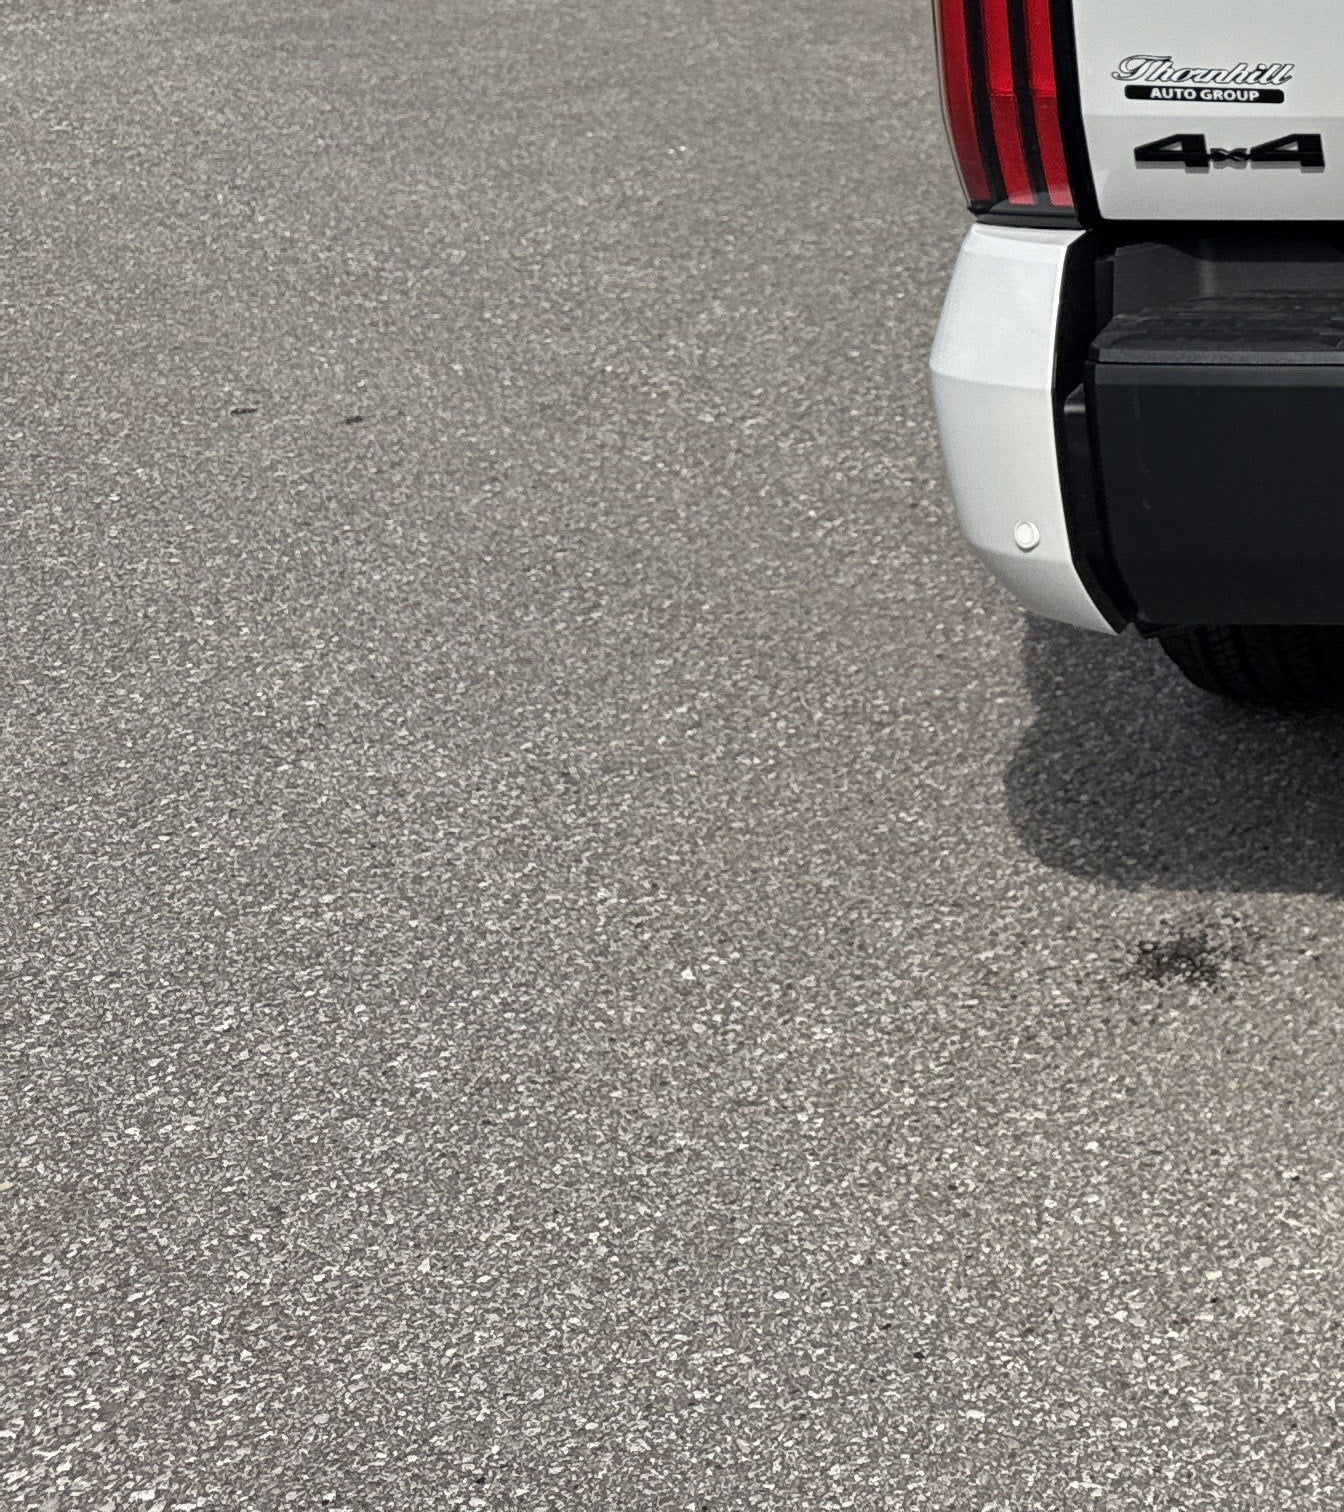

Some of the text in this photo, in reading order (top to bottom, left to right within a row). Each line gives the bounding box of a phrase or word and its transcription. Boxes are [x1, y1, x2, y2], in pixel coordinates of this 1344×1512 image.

[1111, 54, 1296, 86] Thornhill
[1150, 87, 1260, 103] AUTO GROUP
[1133, 133, 1326, 168] 4x4
